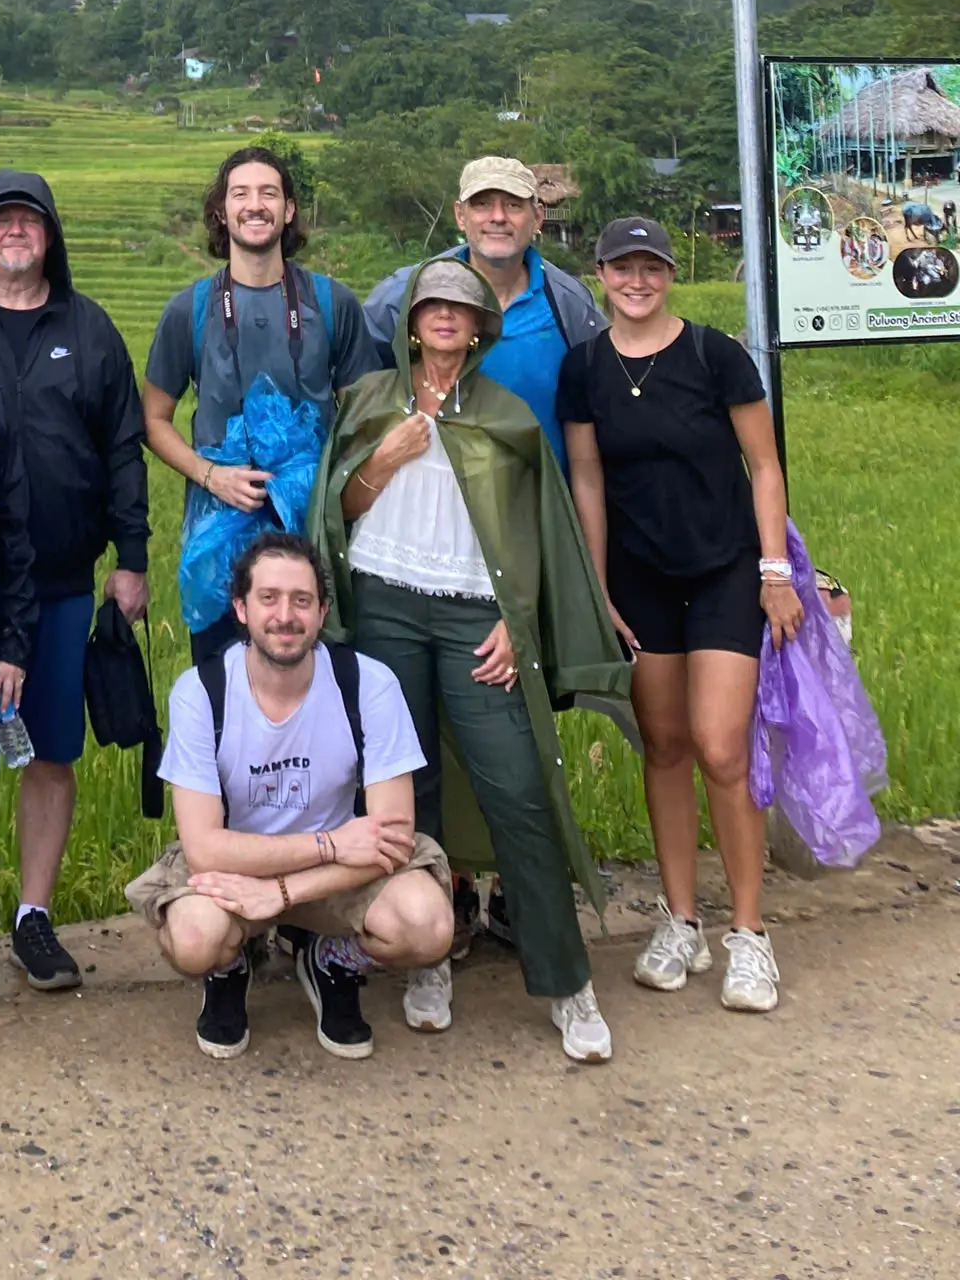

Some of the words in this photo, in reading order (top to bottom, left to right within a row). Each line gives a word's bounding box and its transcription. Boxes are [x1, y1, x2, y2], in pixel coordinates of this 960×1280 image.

[224, 291, 232, 318] Canon
[290, 310, 298, 328] EOS
[869, 314, 909, 327] Puluong
[911, 313, 947, 324] Ancient
[249, 757, 310, 775] WANTED
